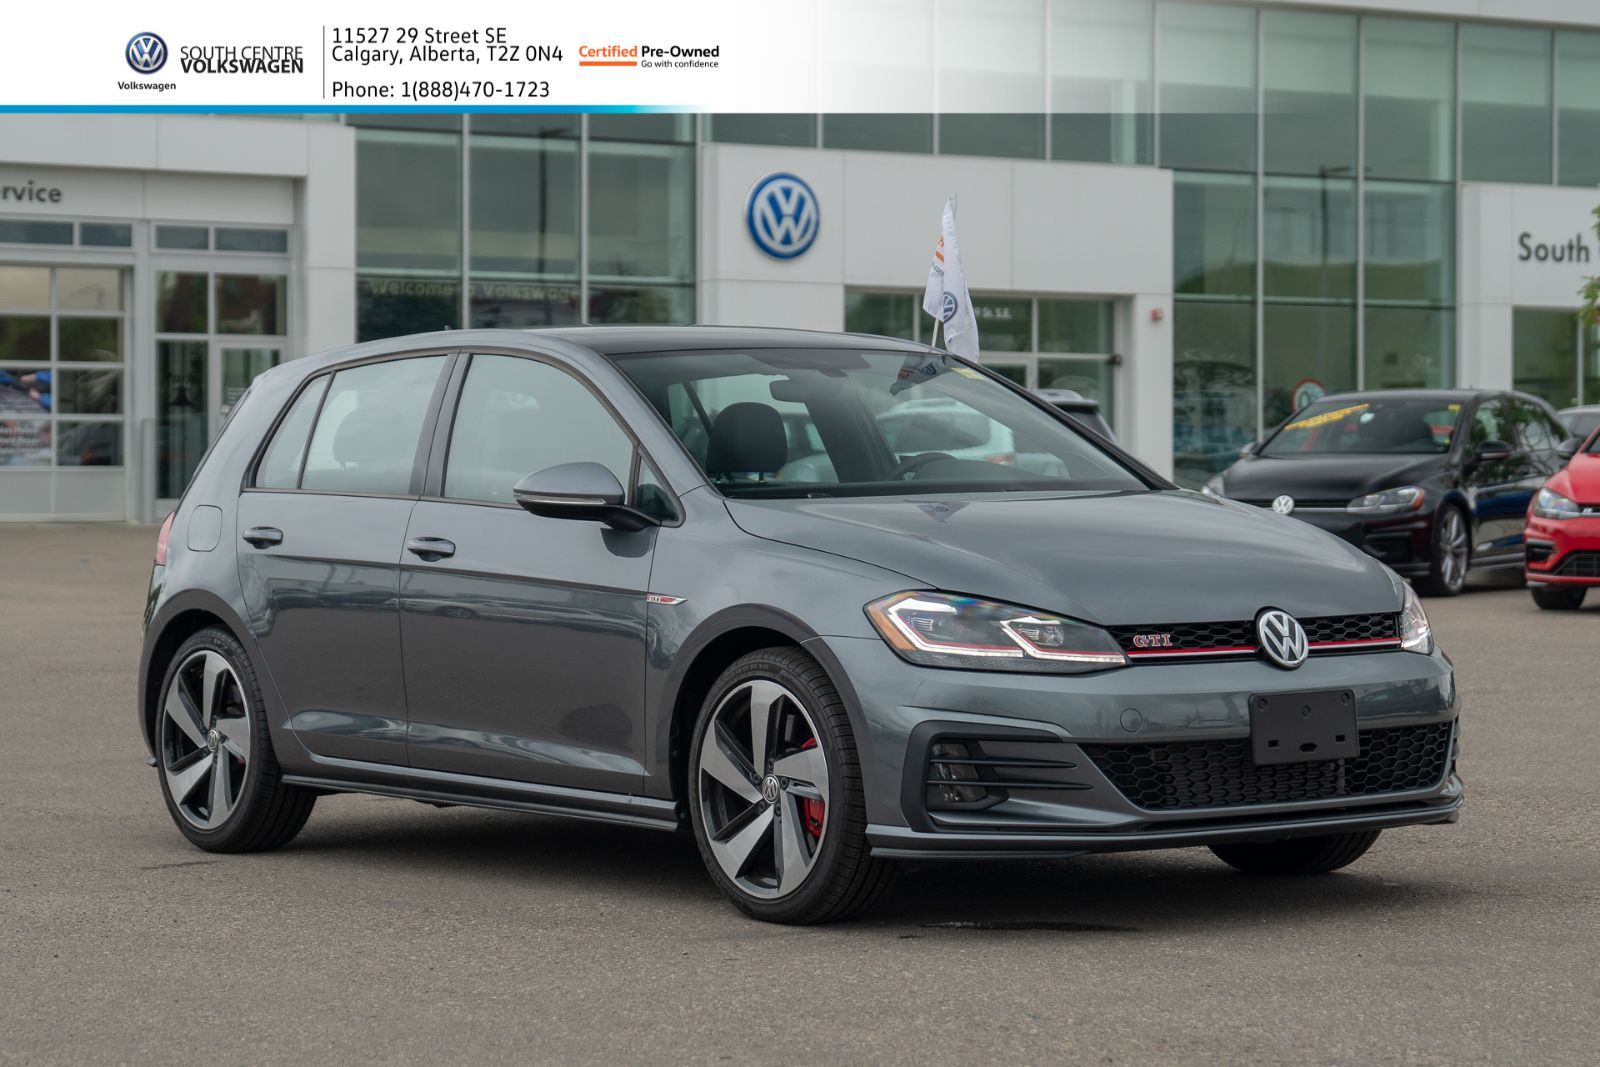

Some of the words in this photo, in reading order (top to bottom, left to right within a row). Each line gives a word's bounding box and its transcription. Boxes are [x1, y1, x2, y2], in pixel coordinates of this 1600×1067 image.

[0, 180, 62, 202] rvice
[1518, 231, 1589, 263] South
[370, 279, 455, 297] Welcome
[482, 283, 581, 303] Volkswage
[1132, 633, 1172, 648] GTI
